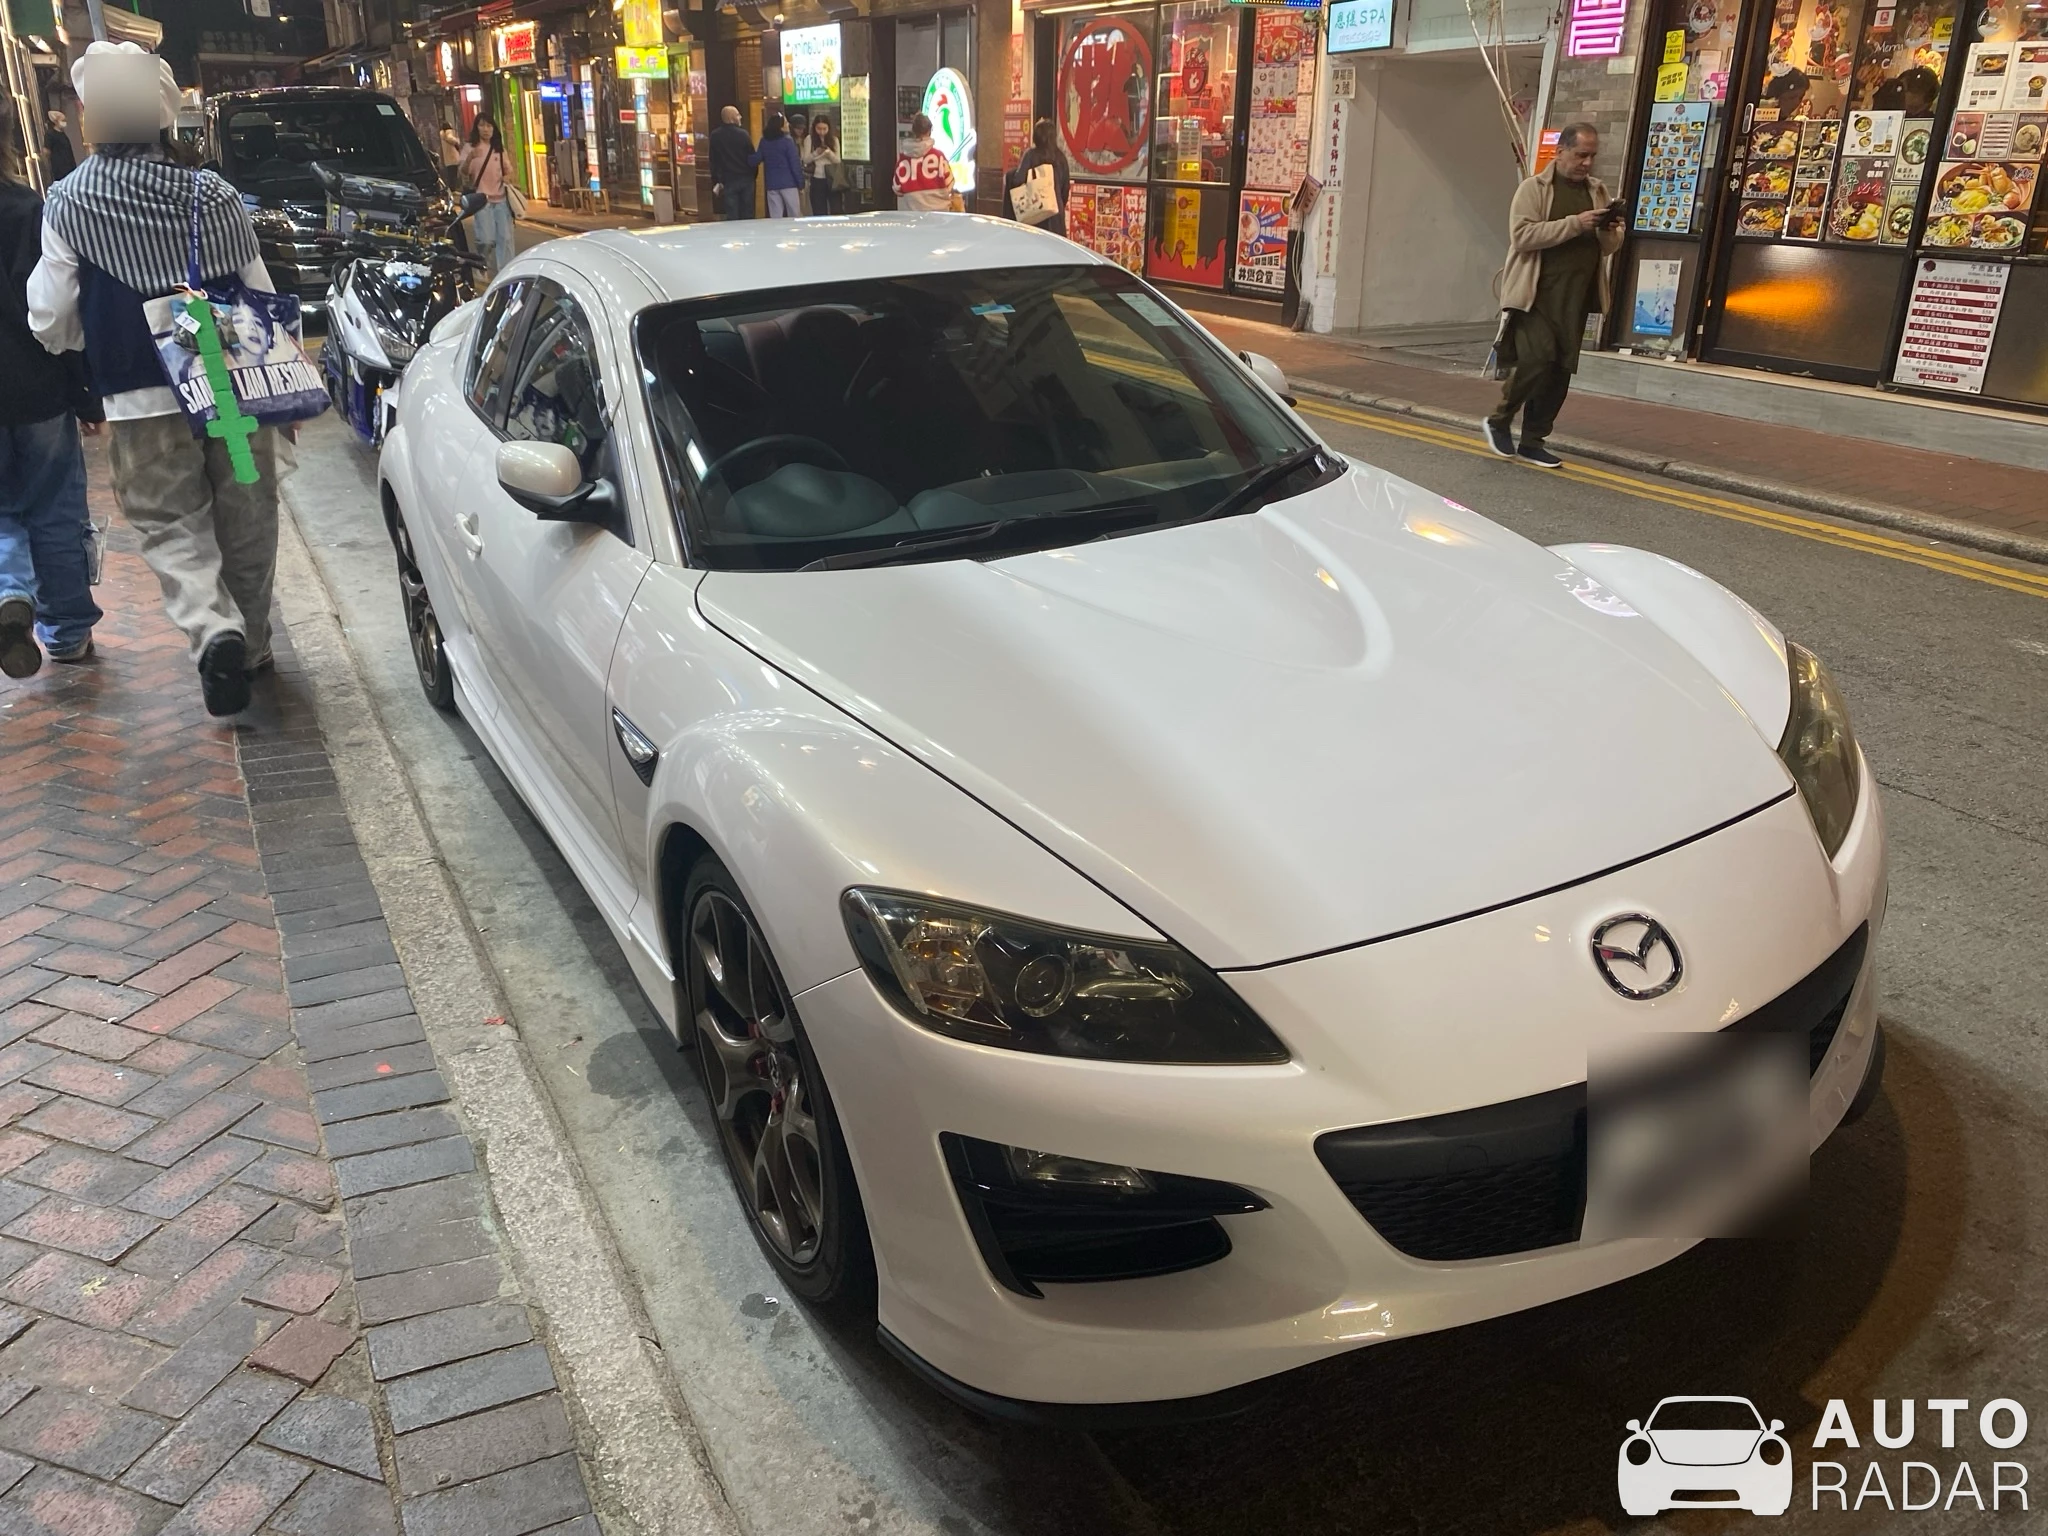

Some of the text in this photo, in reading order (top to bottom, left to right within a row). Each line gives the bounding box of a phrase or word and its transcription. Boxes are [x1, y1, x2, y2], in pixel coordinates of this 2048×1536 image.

[1360, 8, 1386, 24] SPA
[1874, 41, 1904, 53] Merry
[1335, 84, 1340, 94] 2
[184, 316, 195, 328] 17
[232, 366, 270, 400] LAM
